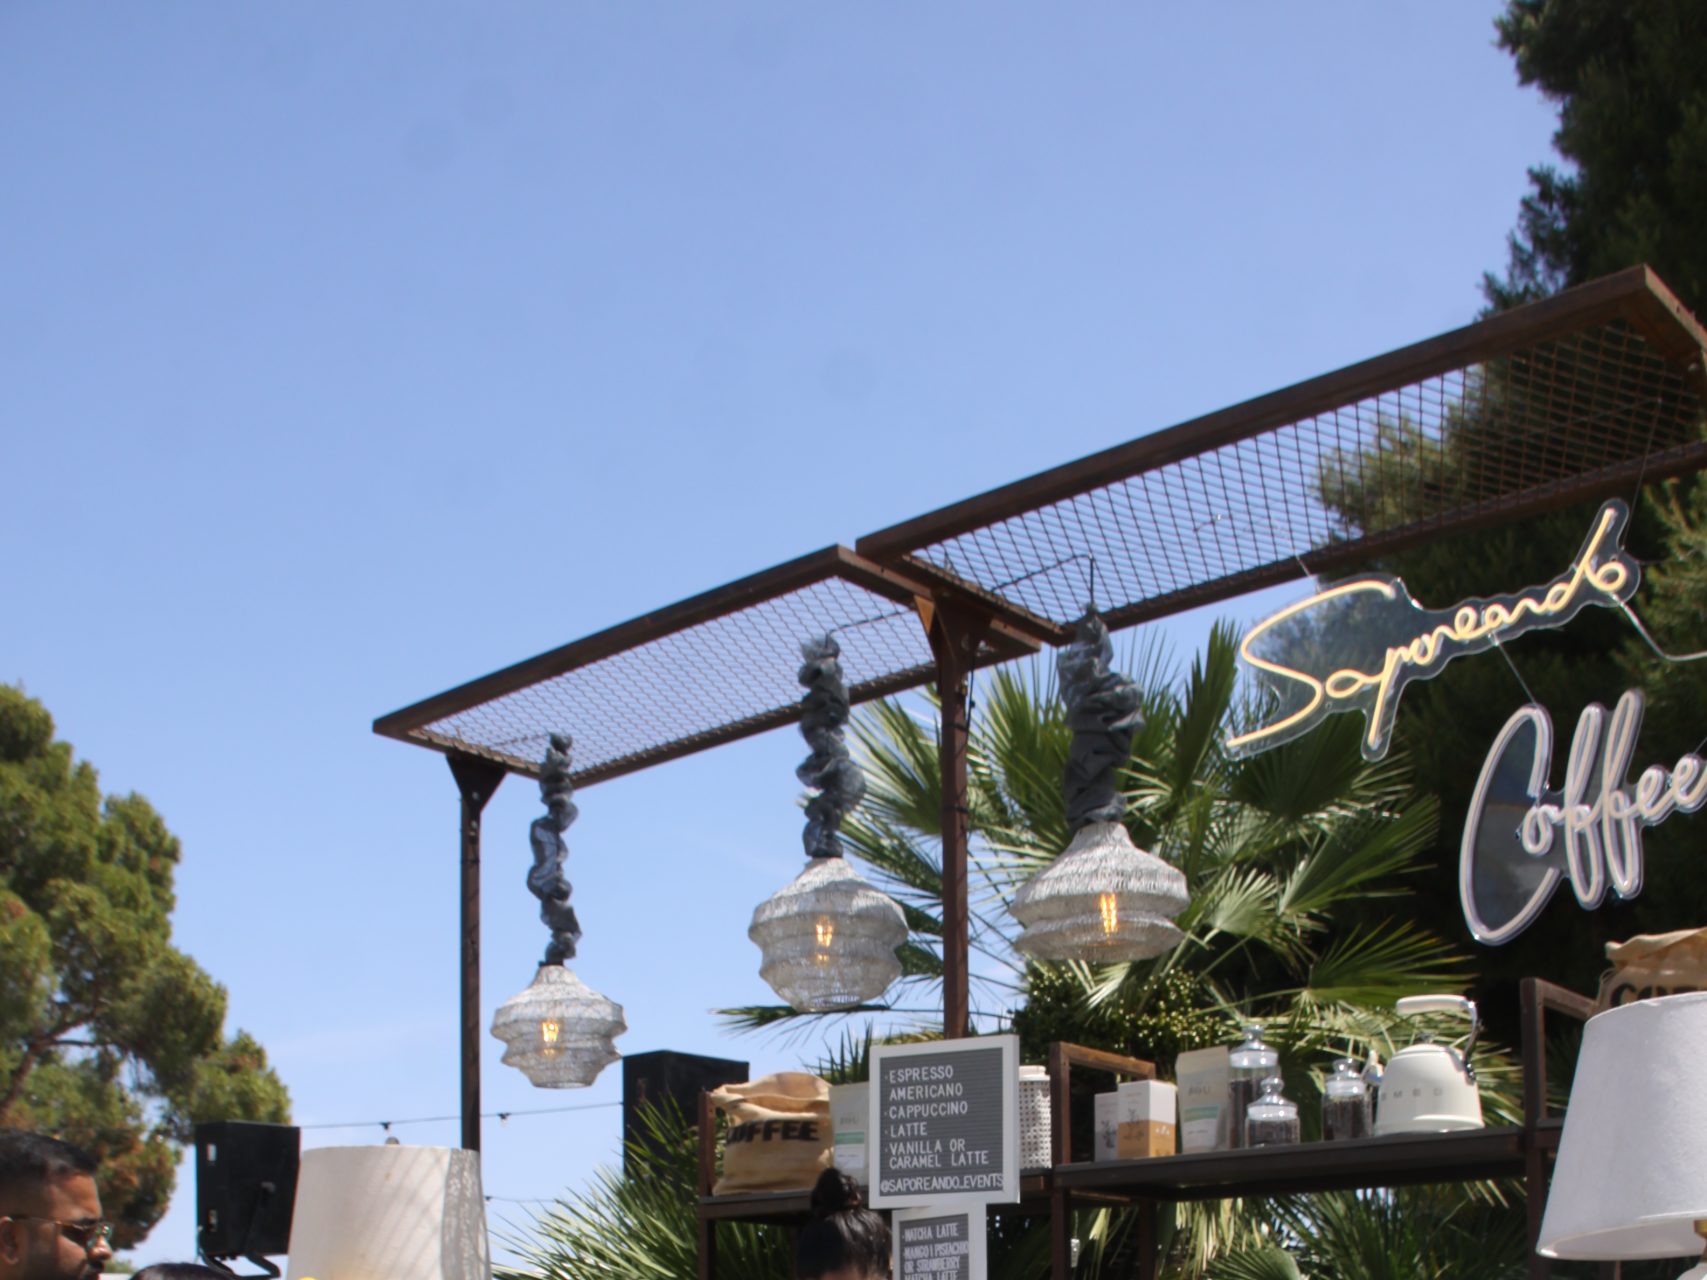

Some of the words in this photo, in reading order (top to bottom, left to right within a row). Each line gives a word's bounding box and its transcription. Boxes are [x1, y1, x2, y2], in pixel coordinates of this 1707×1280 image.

[1225, 507, 1628, 748] Saporeando
[1460, 691, 1707, 944] Coffee
[889, 1064, 954, 1084] ESPRESSO
[889, 1082, 963, 1101] AMERICANO
[889, 1100, 968, 1119] CAPPUCCINO
[890, 1121, 928, 1138] LATTE
[889, 1139, 943, 1156] VANILLA
[949, 1138, 966, 1152] OR
[889, 1154, 942, 1169] CARAMEL
[951, 1150, 989, 1166] LATTE
[937, 1223, 959, 1238] LATTE
[905, 1262, 914, 1274] OR
